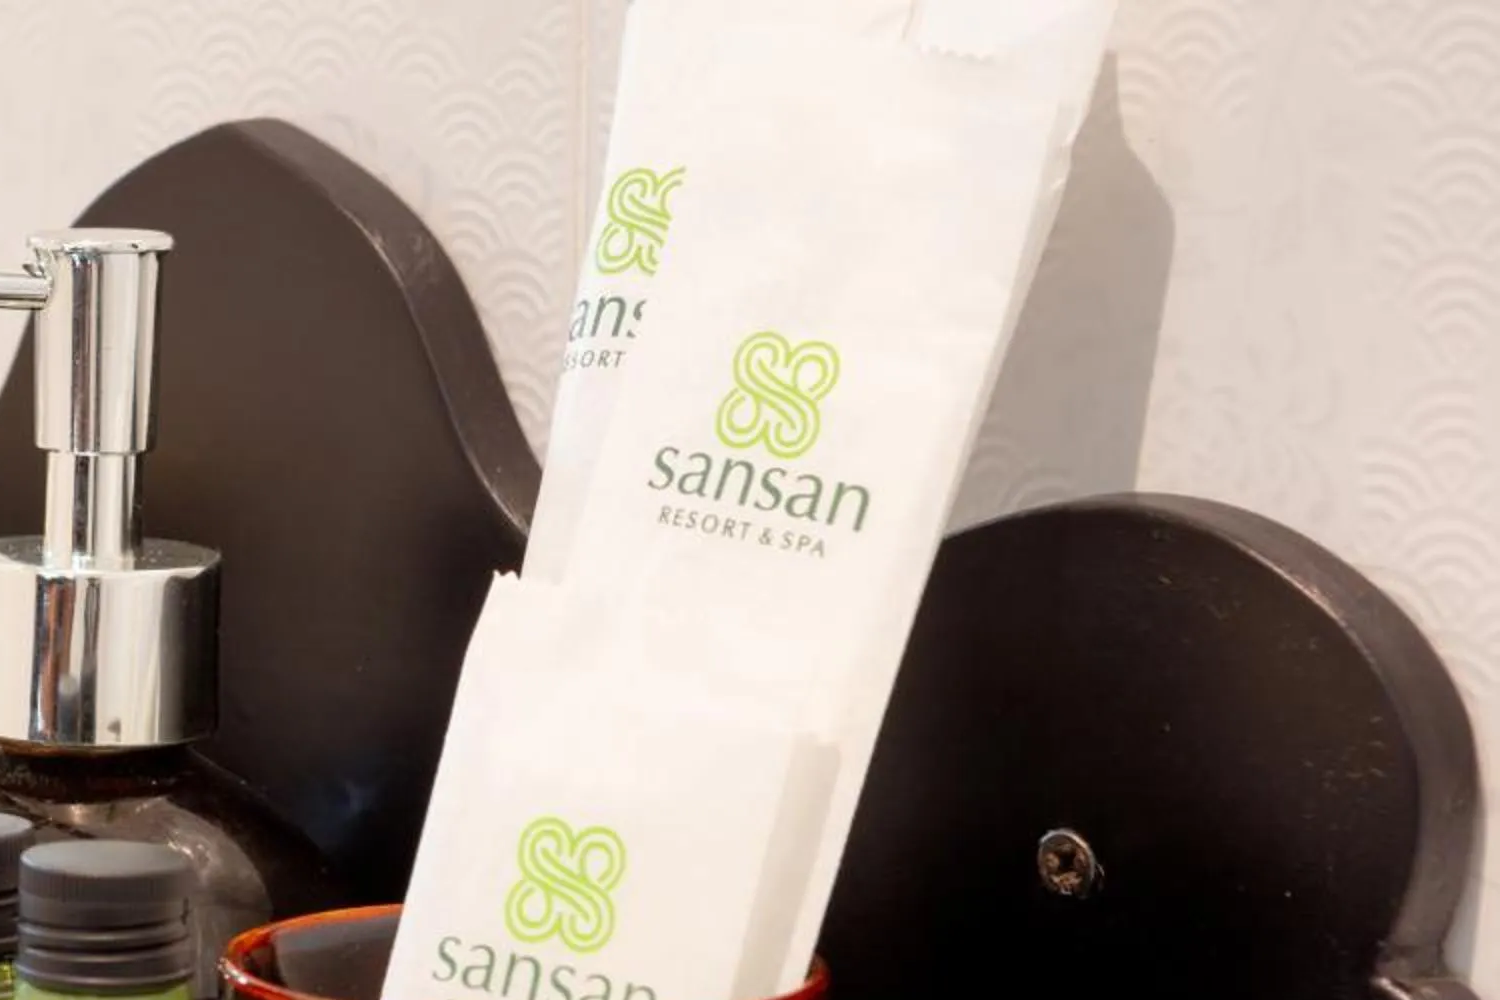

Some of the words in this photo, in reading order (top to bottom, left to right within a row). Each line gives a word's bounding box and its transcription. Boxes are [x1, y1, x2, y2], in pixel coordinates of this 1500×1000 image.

[647, 445, 870, 533] sansan
[657, 505, 752, 541] RESORT
[757, 527, 774, 547] &
[779, 530, 826, 558] SPA
